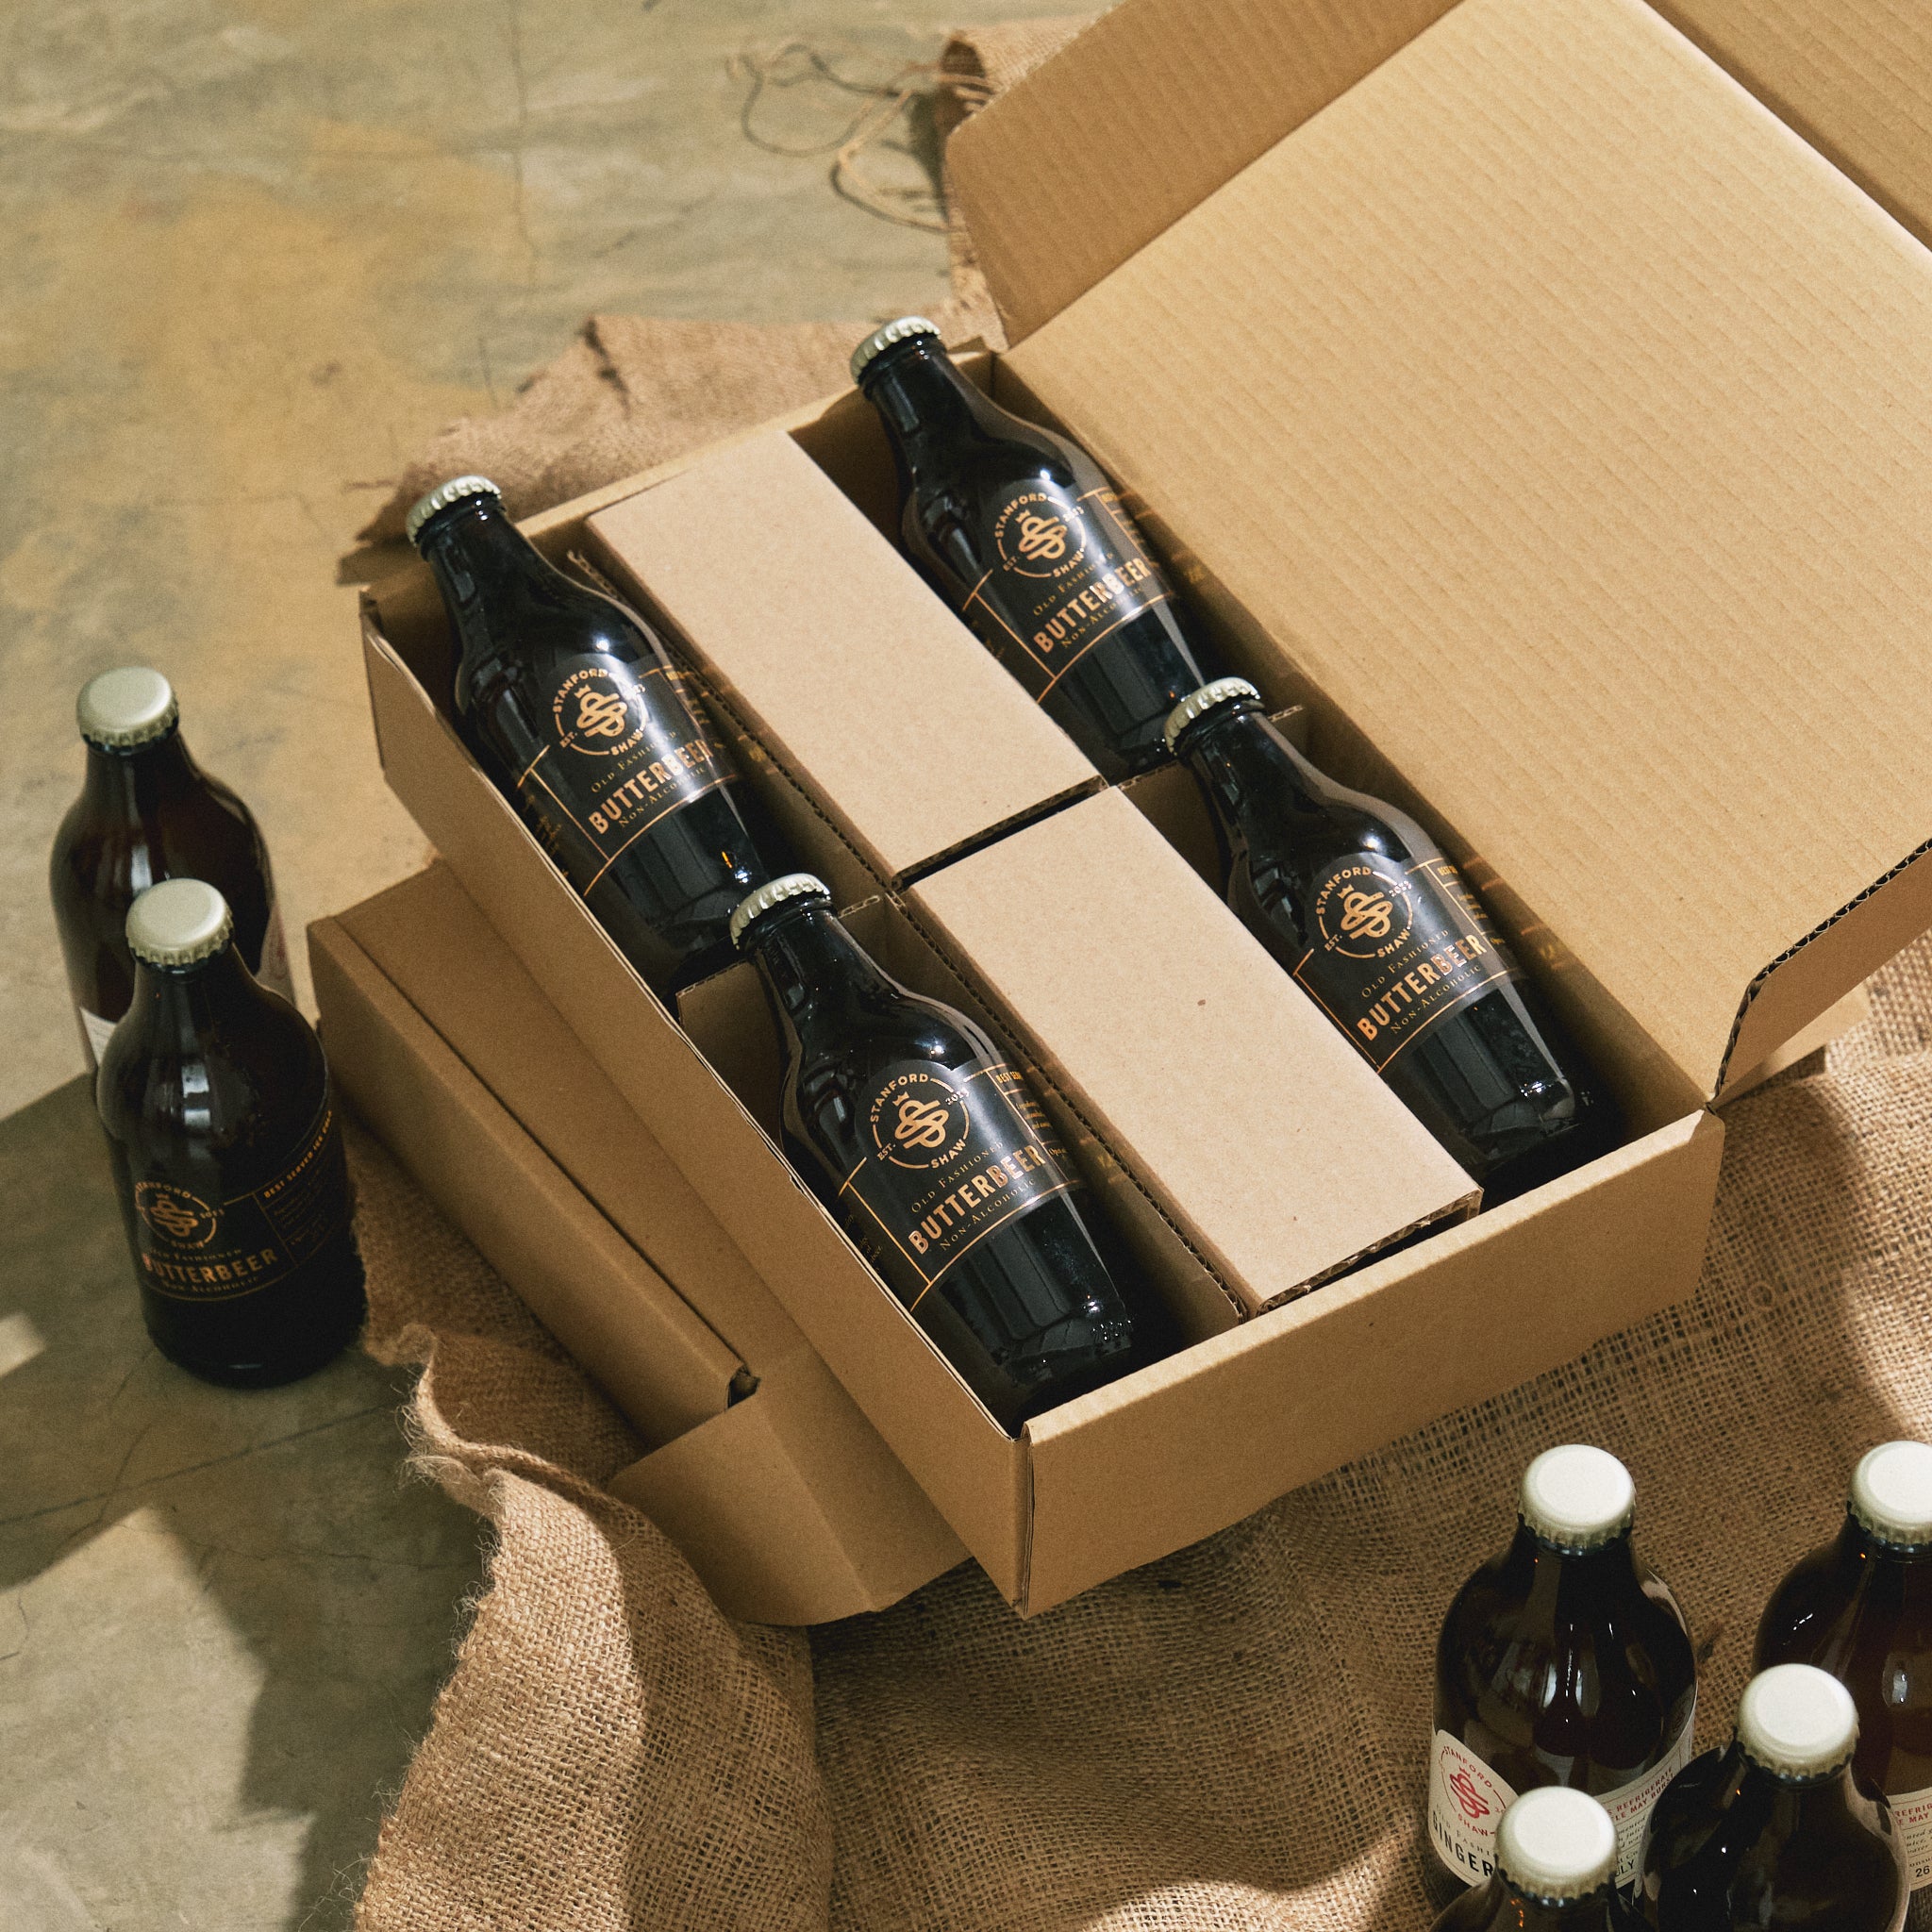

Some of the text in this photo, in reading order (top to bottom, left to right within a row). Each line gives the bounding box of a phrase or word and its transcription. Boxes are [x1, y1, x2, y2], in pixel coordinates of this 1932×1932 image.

[995, 492, 1047, 538] STANFORD
[1053, 550, 1084, 578] SHAW
[1033, 594, 1057, 616] OLD
[1033, 558, 1152, 654] BUTTERBEER
[553, 668, 609, 712] STANFORD
[559, 731, 578, 748] EST.
[611, 727, 644, 756] SHAW
[589, 739, 713, 835] BUTTERBEER
[591, 773, 615, 793] OLD
[1316, 866, 1372, 914] STANFORD
[1324, 934, 1343, 952] EST.
[1376, 928, 1410, 958] SHAW
[1361, 929, 1449, 998] OLD FASHIONED
[1357, 934, 1487, 1041] BUTTERBEER
[1391, 964, 1482, 1034] NON-ALCOHOLIC
[870, 1073, 928, 1123] STANFORD
[876, 1143, 896, 1161] EST.
[930, 1139, 966, 1169] SHAW
[911, 1141, 1004, 1213] OLD FASHIONED
[908, 1144, 1046, 1255] BUTTERBEER
[940, 1178, 1036, 1251] NON-ALCOHOLIC
[142, 1248, 278, 1284] BUTTERBEER
[1443, 1745, 1493, 1788] STANFORD
[1617, 1766, 1674, 1812] REFRIGERATE
[1630, 1799, 1648, 1814] MAY
[1457, 1813, 1489, 1837] SHAW
[1895, 1803, 1932, 1817] REFRIG
[1909, 1812, 1929, 1824] MAY
[1432, 1809, 1494, 1877] GINGER
[1456, 1829, 1491, 1856] FASHI
[1915, 1865, 1930, 1877] 26
